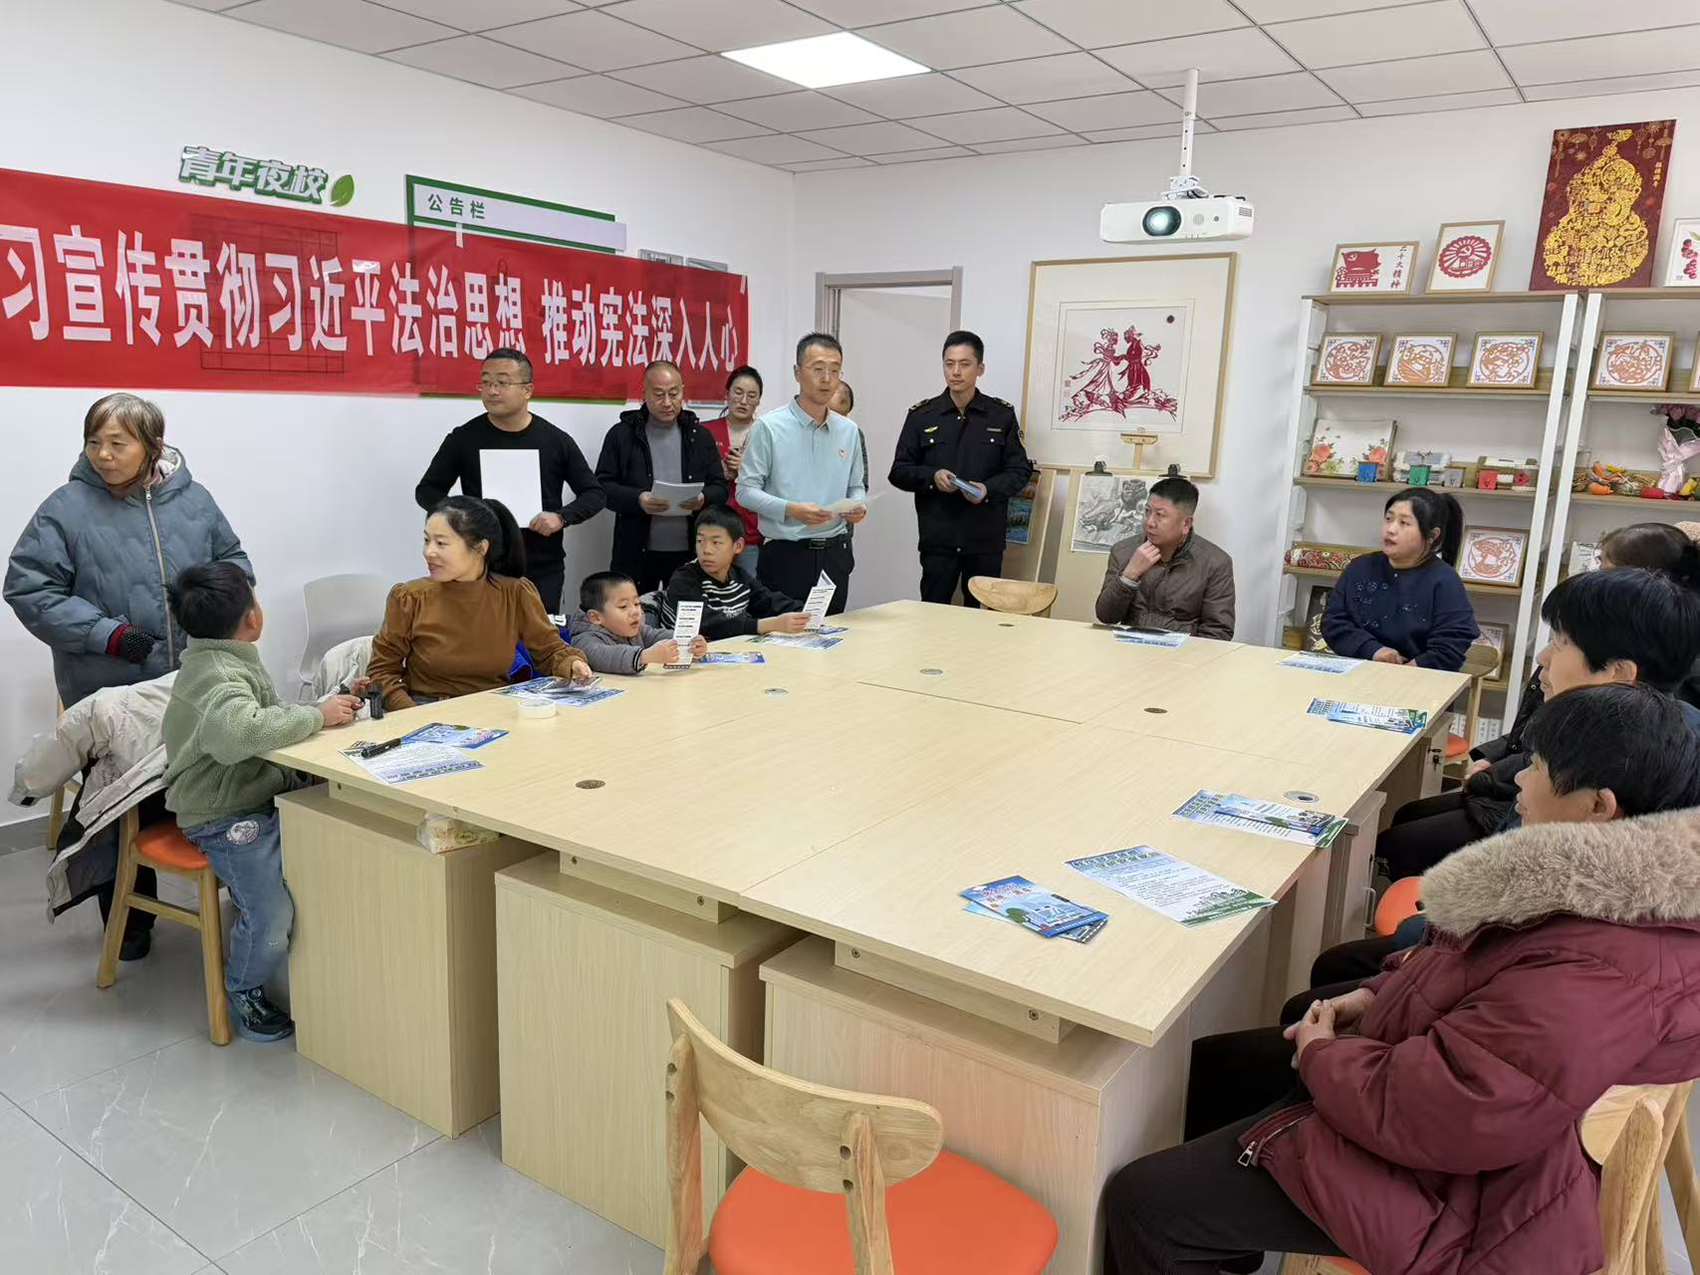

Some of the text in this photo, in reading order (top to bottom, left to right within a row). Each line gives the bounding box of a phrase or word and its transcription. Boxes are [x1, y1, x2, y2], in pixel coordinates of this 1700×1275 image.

[179, 146, 328, 204] 青年夜校
[428, 193, 486, 220] 公告栏
[0, 224, 737, 371] 习宣传贯彻习近平法治思想 推动宪法深入人心
